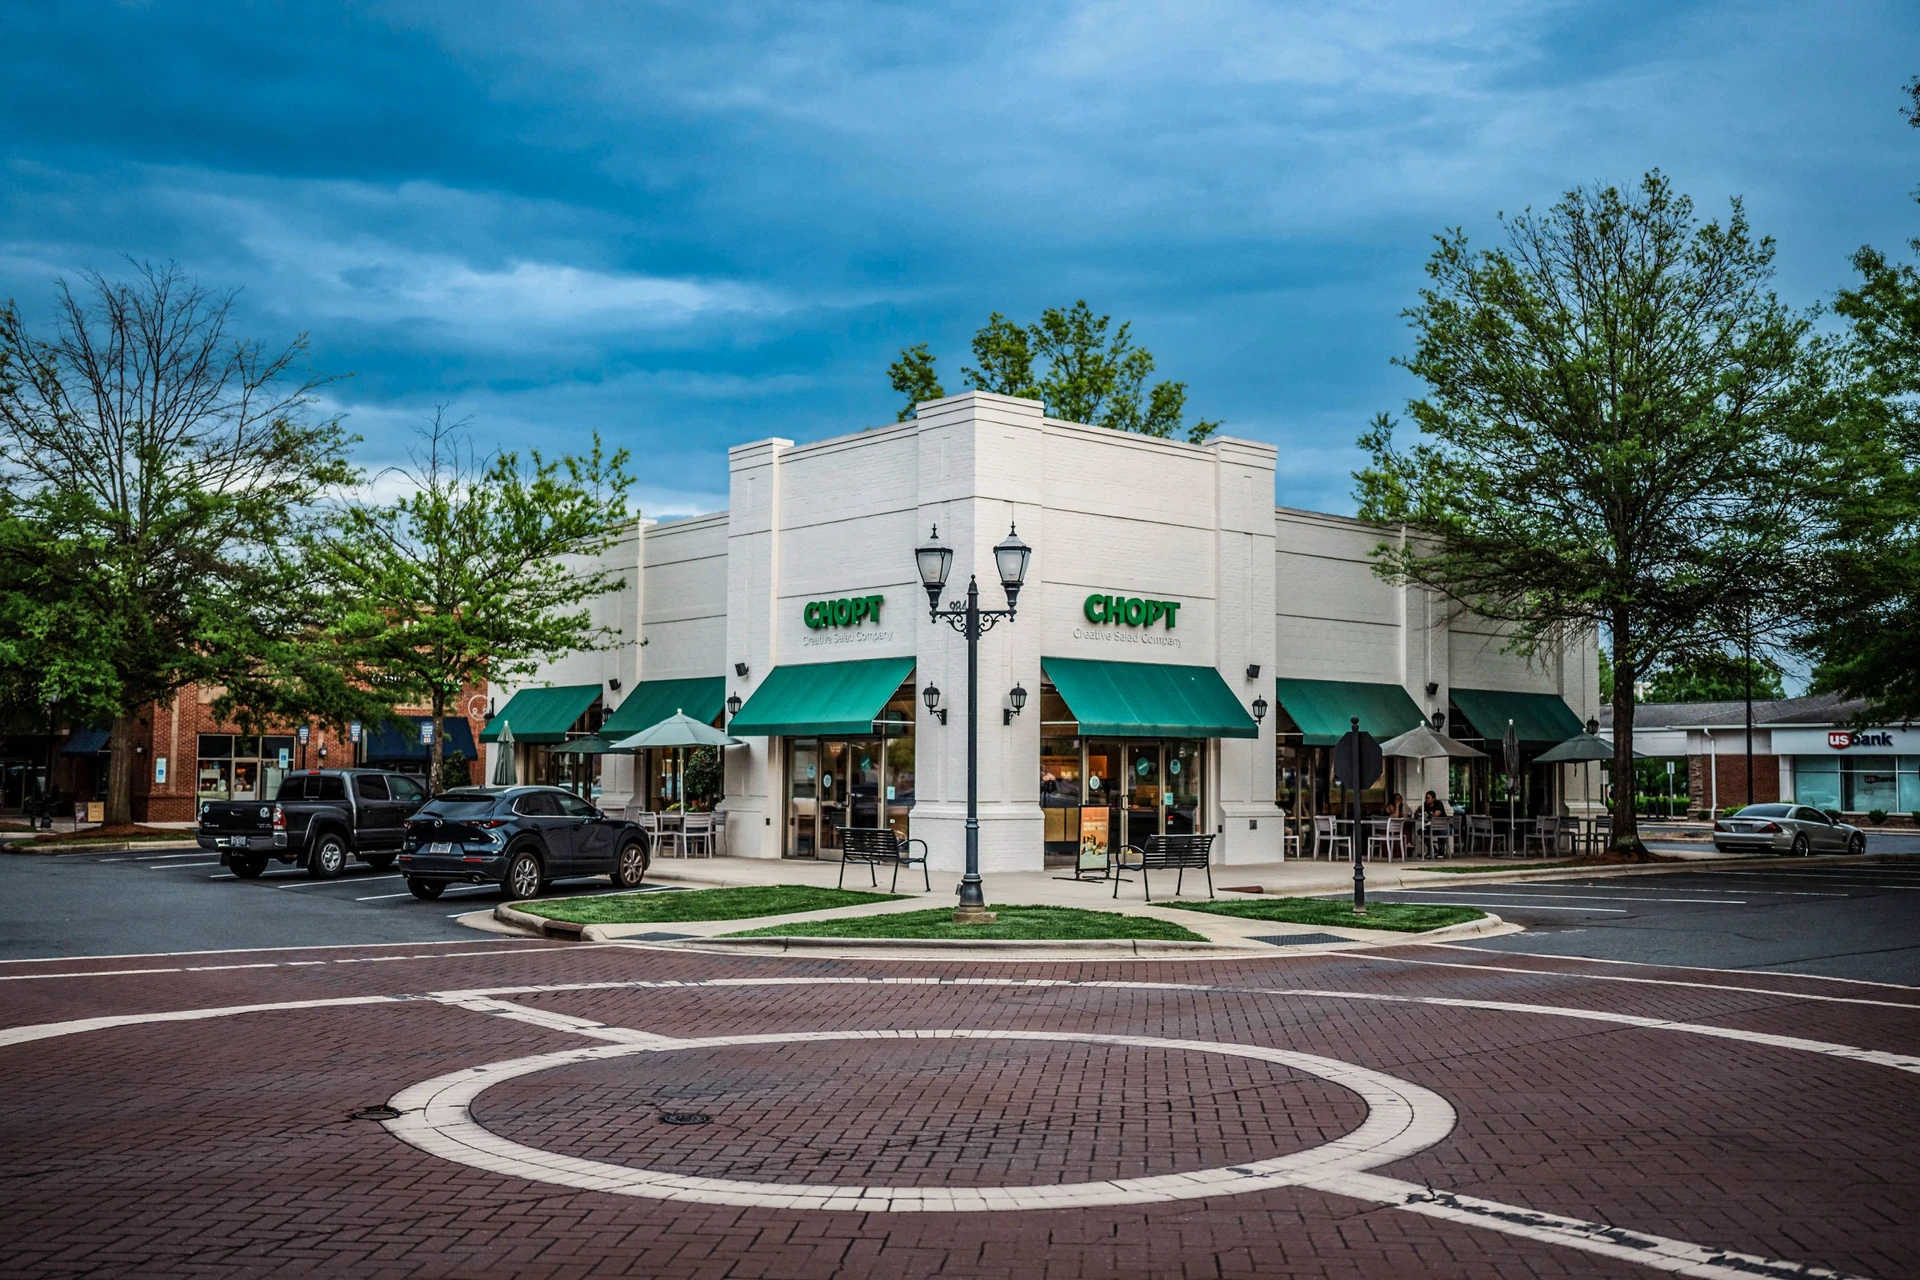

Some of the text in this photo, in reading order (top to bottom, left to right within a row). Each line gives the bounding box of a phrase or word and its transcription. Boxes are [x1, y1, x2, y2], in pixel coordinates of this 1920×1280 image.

[804, 595, 884, 628] CHOPT
[1084, 594, 1181, 628] CHOPT
[803, 631, 893, 646] Creative Salad Company
[1073, 629, 1182, 648] Creative Salad Company
